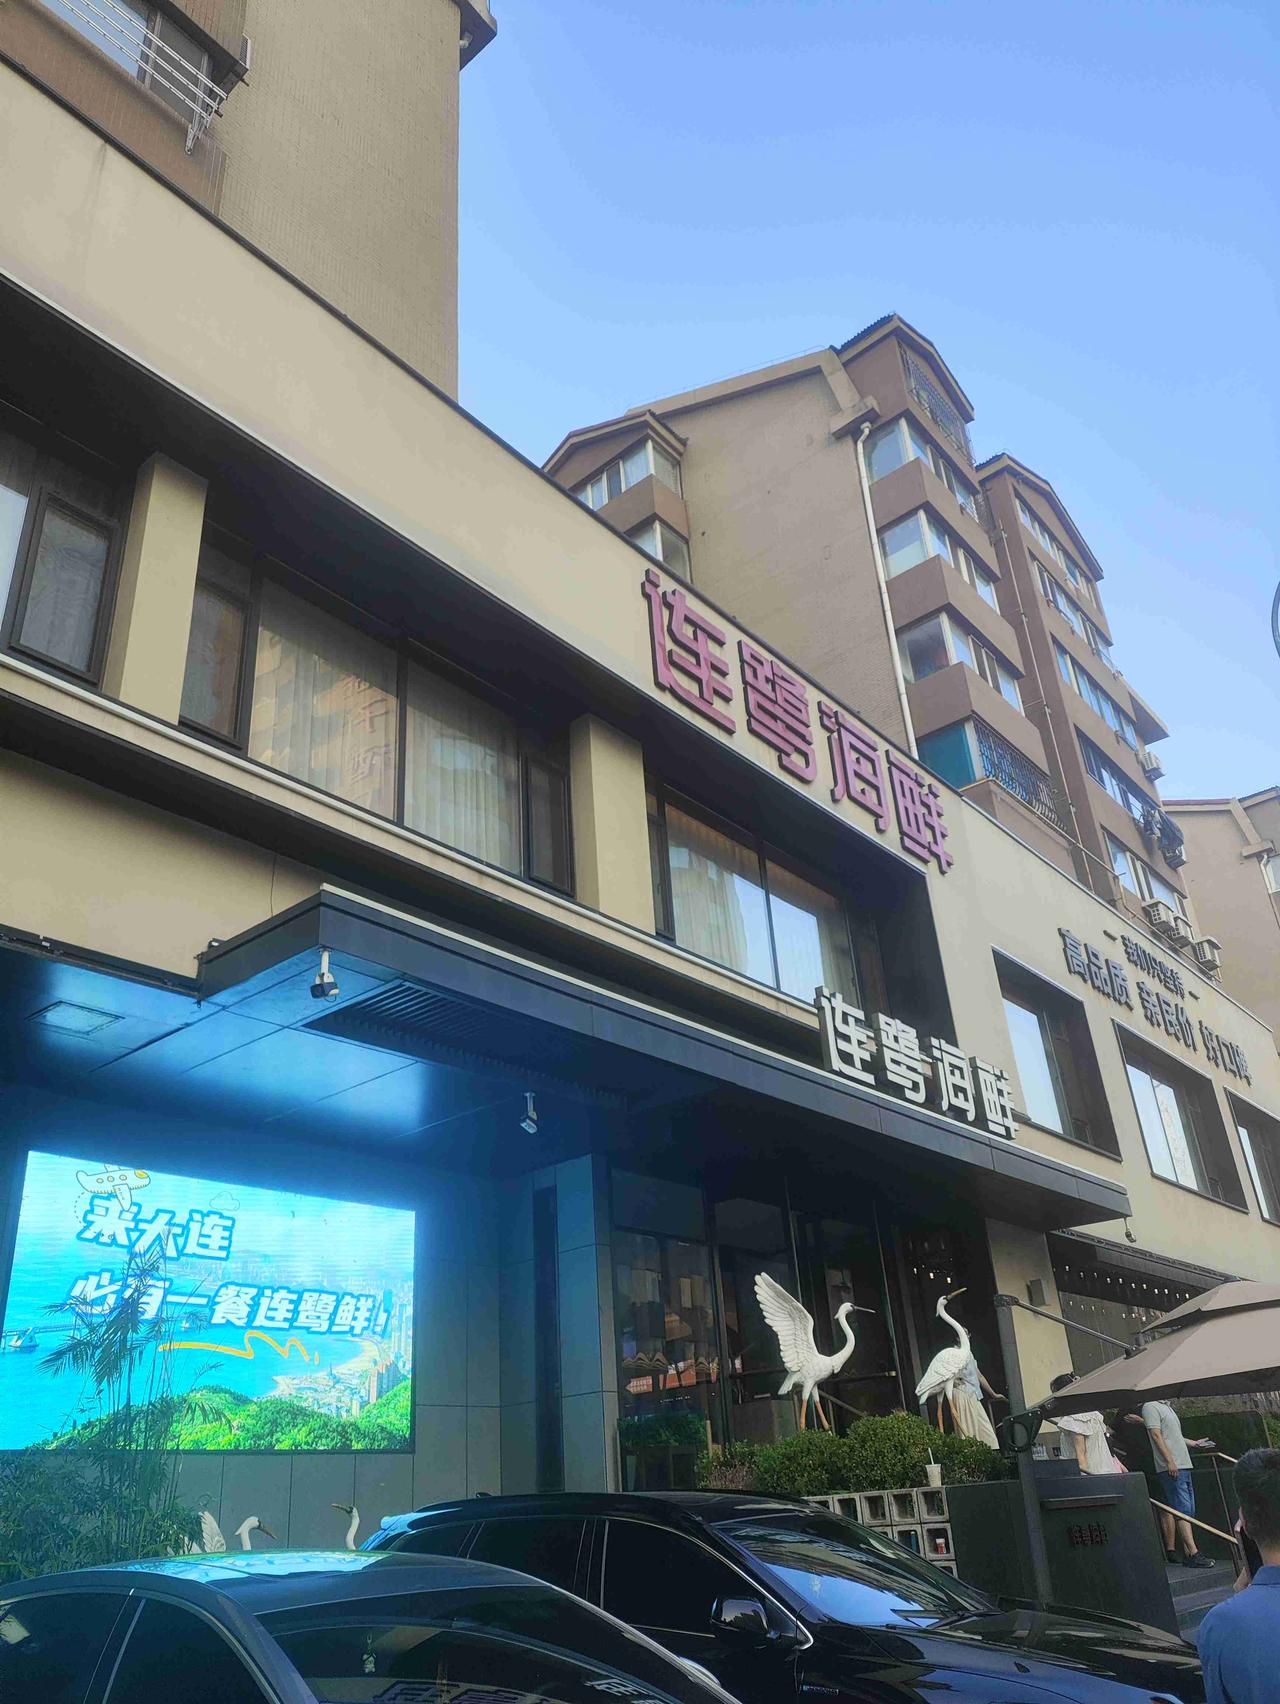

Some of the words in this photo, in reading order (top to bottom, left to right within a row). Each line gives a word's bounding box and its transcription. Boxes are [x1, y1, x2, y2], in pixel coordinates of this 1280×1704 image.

[640, 567, 954, 876] 连鹭海鲜
[814, 985, 1020, 1140] 连鹭海鲜
[1057, 927, 1134, 1012] 高品质
[1136, 981, 1198, 1054] 亲民价
[1198, 1019, 1253, 1088] 好口碑
[77, 1194, 236, 1261] 来大连
